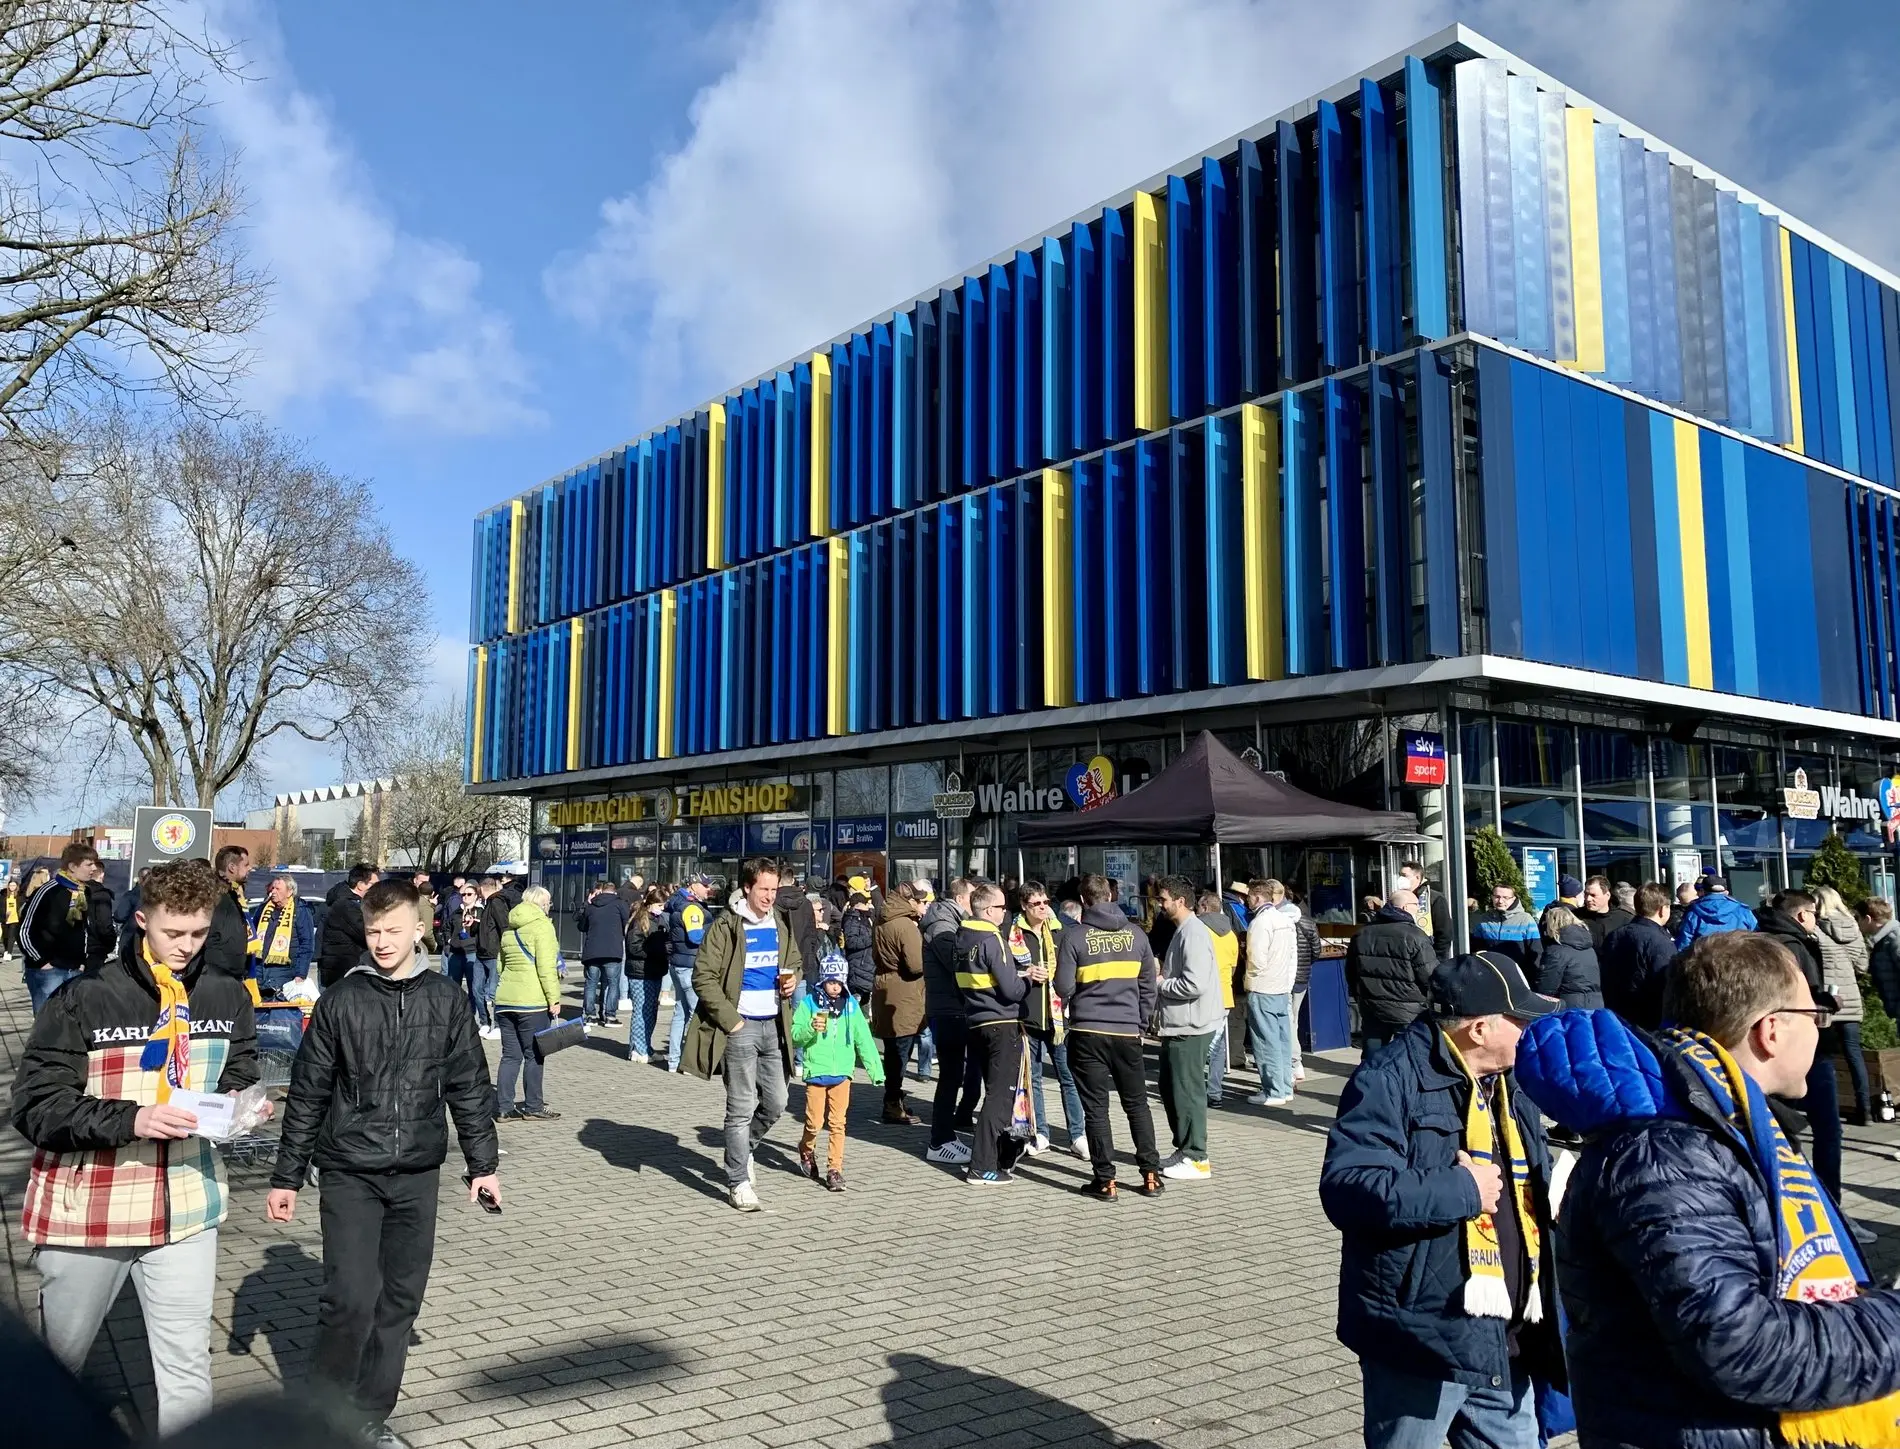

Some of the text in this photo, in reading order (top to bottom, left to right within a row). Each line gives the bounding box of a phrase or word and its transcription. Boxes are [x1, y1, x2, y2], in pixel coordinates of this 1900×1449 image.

[1415, 736, 1434, 757] sky
[1414, 765, 1437, 777] sport
[549, 783, 790, 826] EINTRACHT FANSHOP
[978, 781, 1064, 813] Wahre
[1820, 785, 1880, 820] Wahre
[856, 823, 882, 832] Volksbank
[1086, 934, 1134, 955] BTSV
[820, 963, 844, 973] MSV
[189, 1019, 234, 1034] KANI
